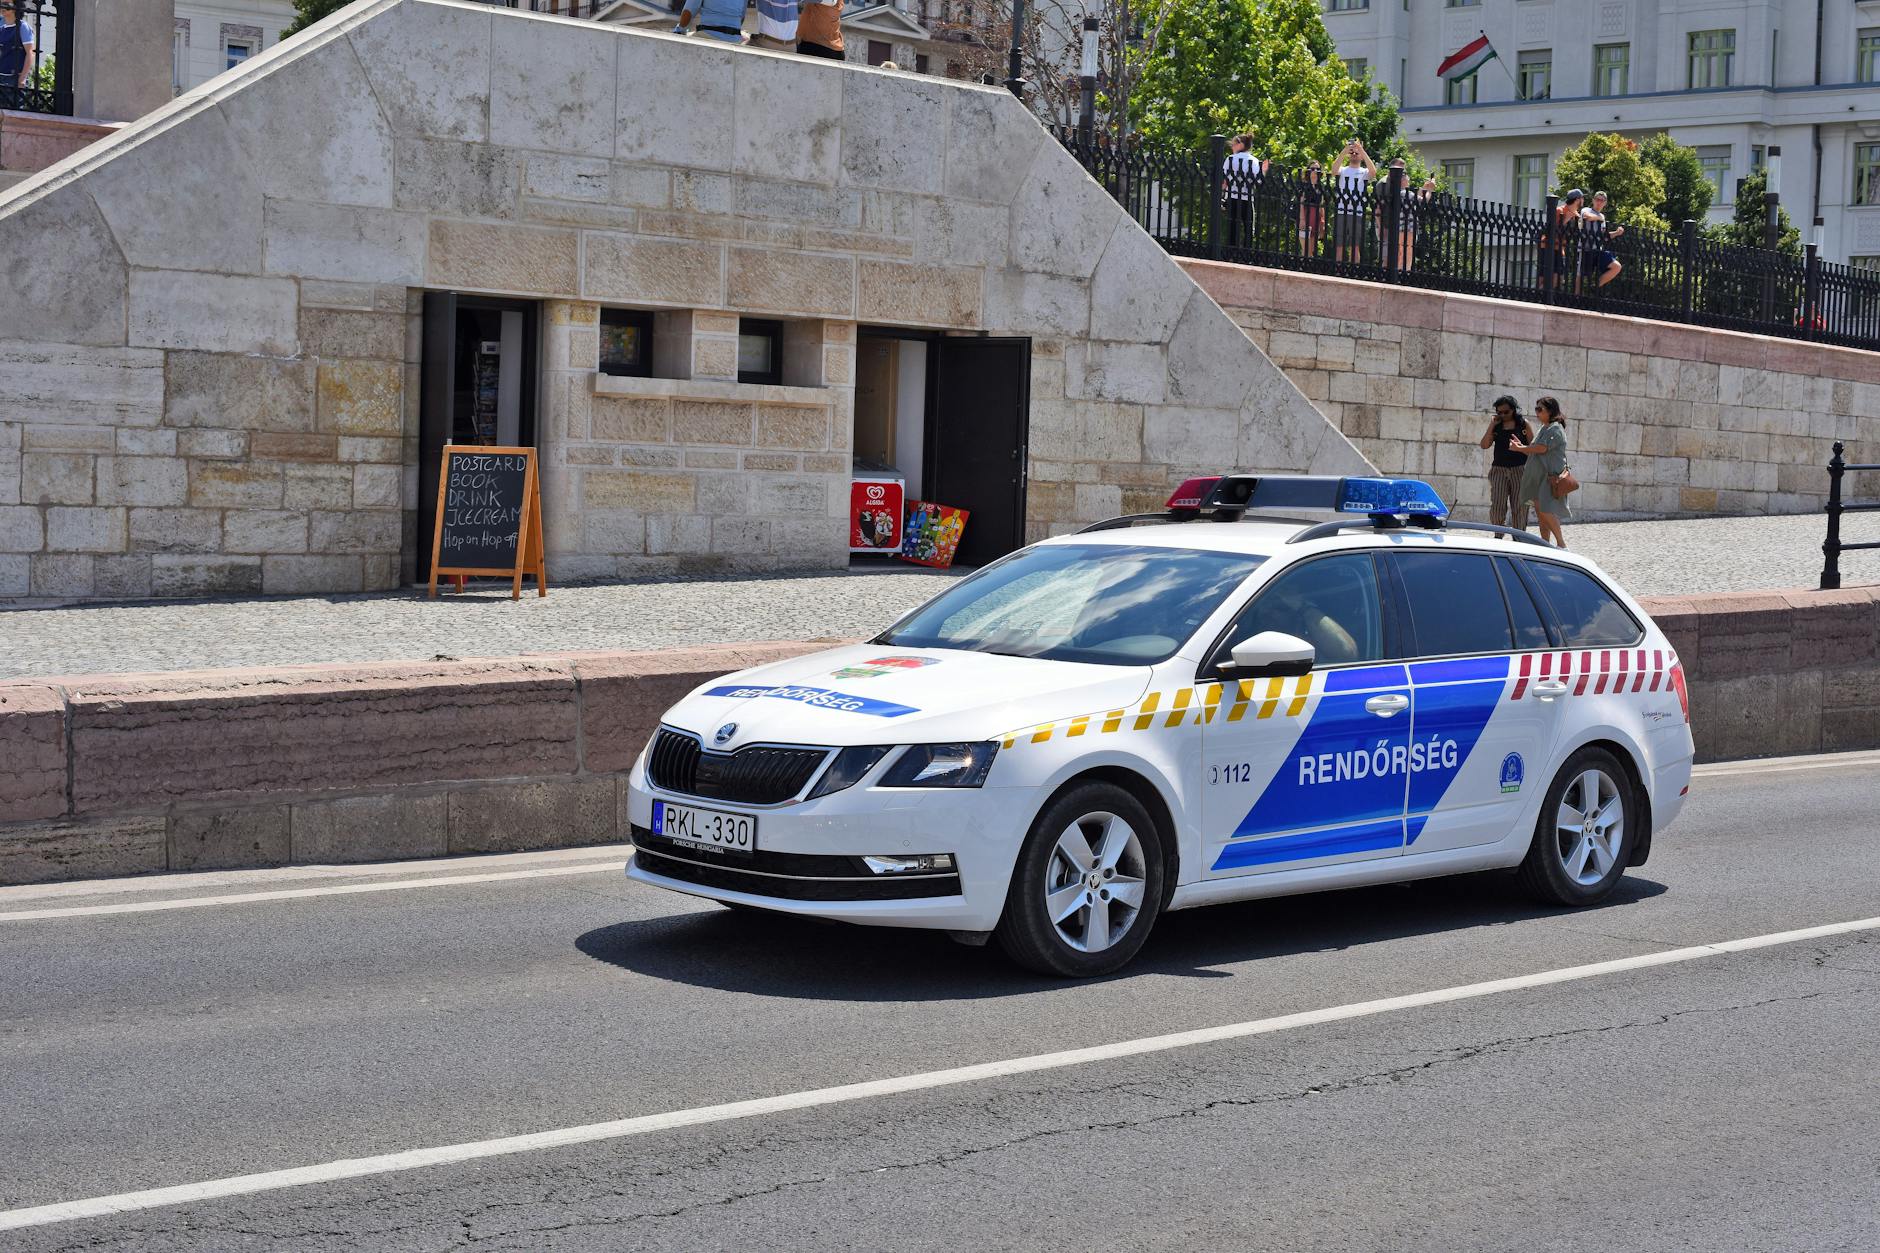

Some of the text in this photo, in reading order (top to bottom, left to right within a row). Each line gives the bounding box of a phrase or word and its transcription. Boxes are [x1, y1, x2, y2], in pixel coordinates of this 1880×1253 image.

[453, 456, 526, 471] POSTCARD
[451, 473, 498, 489] BOOK
[449, 488, 503, 507] DRINK
[444, 528, 518, 551] Hop on Hop off
[1299, 734, 1458, 785] RENDŐRSÉG
[1223, 763, 1251, 784] 112
[655, 820, 661, 830] H
[665, 807, 748, 846] RKL-330
